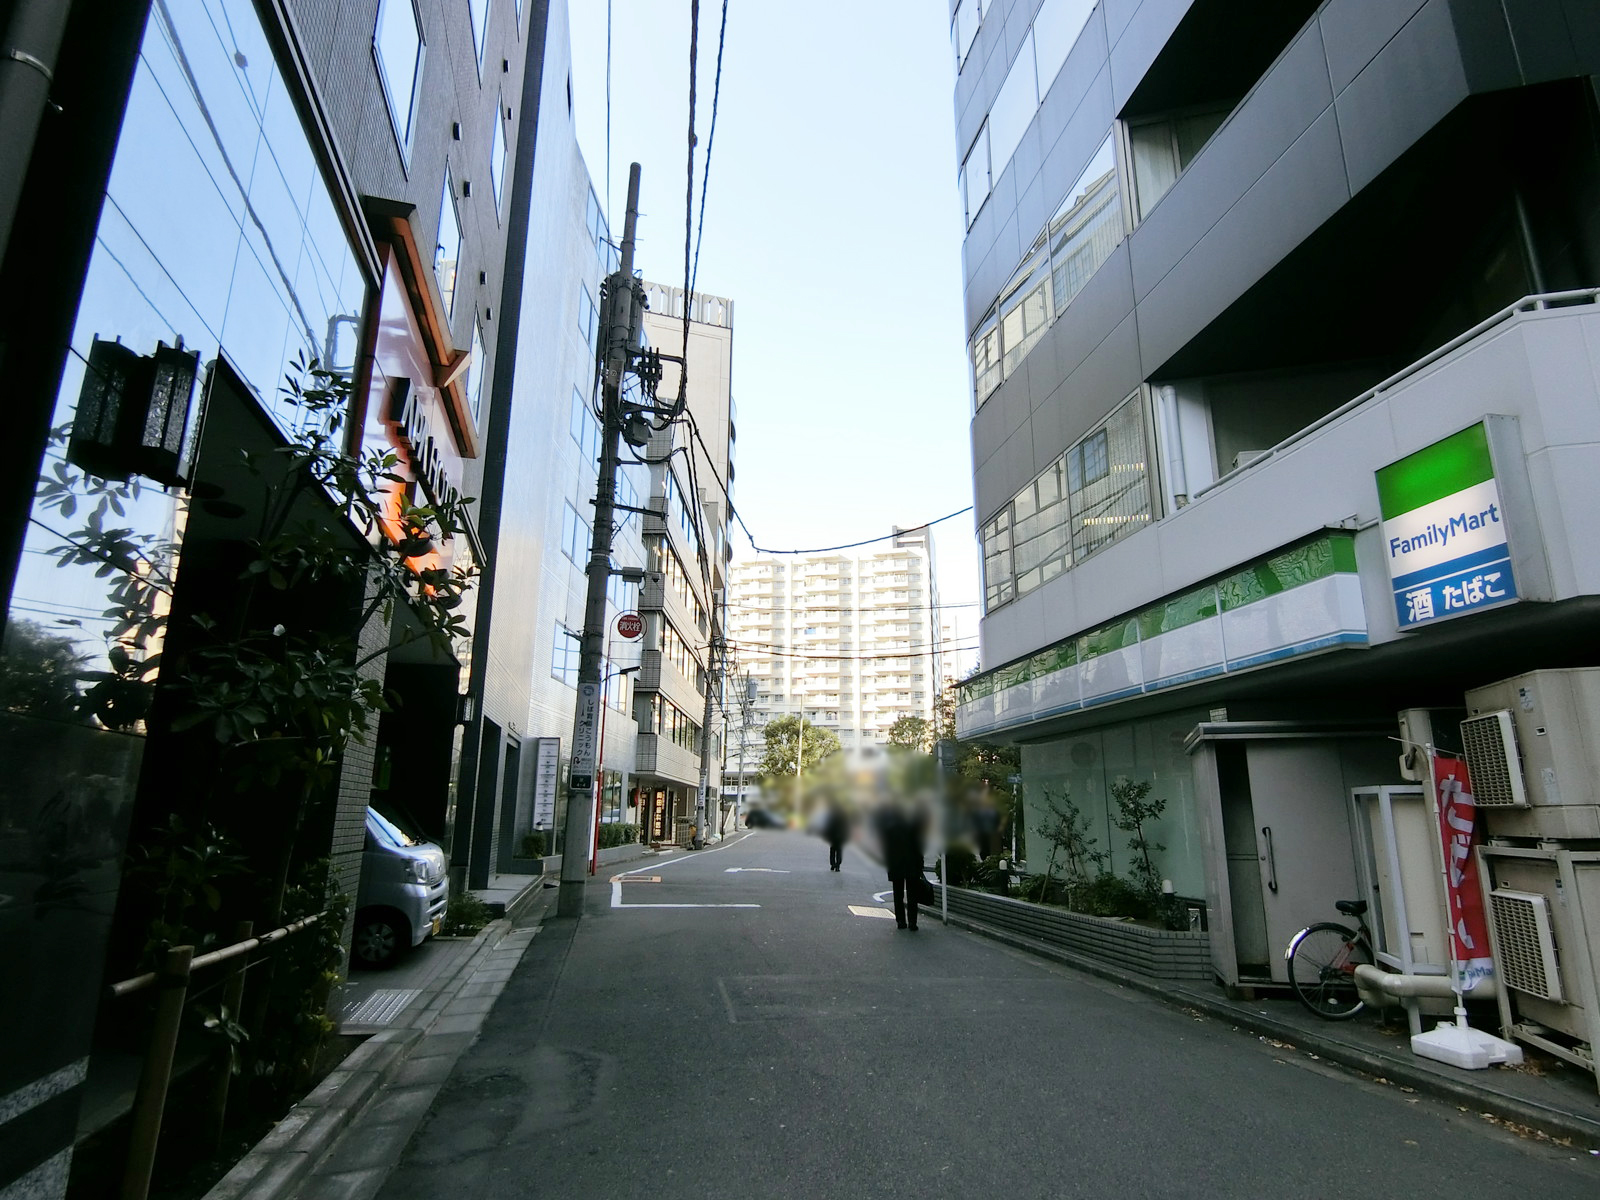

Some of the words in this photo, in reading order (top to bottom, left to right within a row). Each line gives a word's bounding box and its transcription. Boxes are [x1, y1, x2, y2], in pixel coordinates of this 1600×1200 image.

[1390, 503, 1499, 558] FamilyMart
[1406, 587, 1435, 622] 酒
[1442, 572, 1505, 610] たばこ
[619, 621, 641, 632] 消火栓
[576, 720, 586, 756] クリニック
